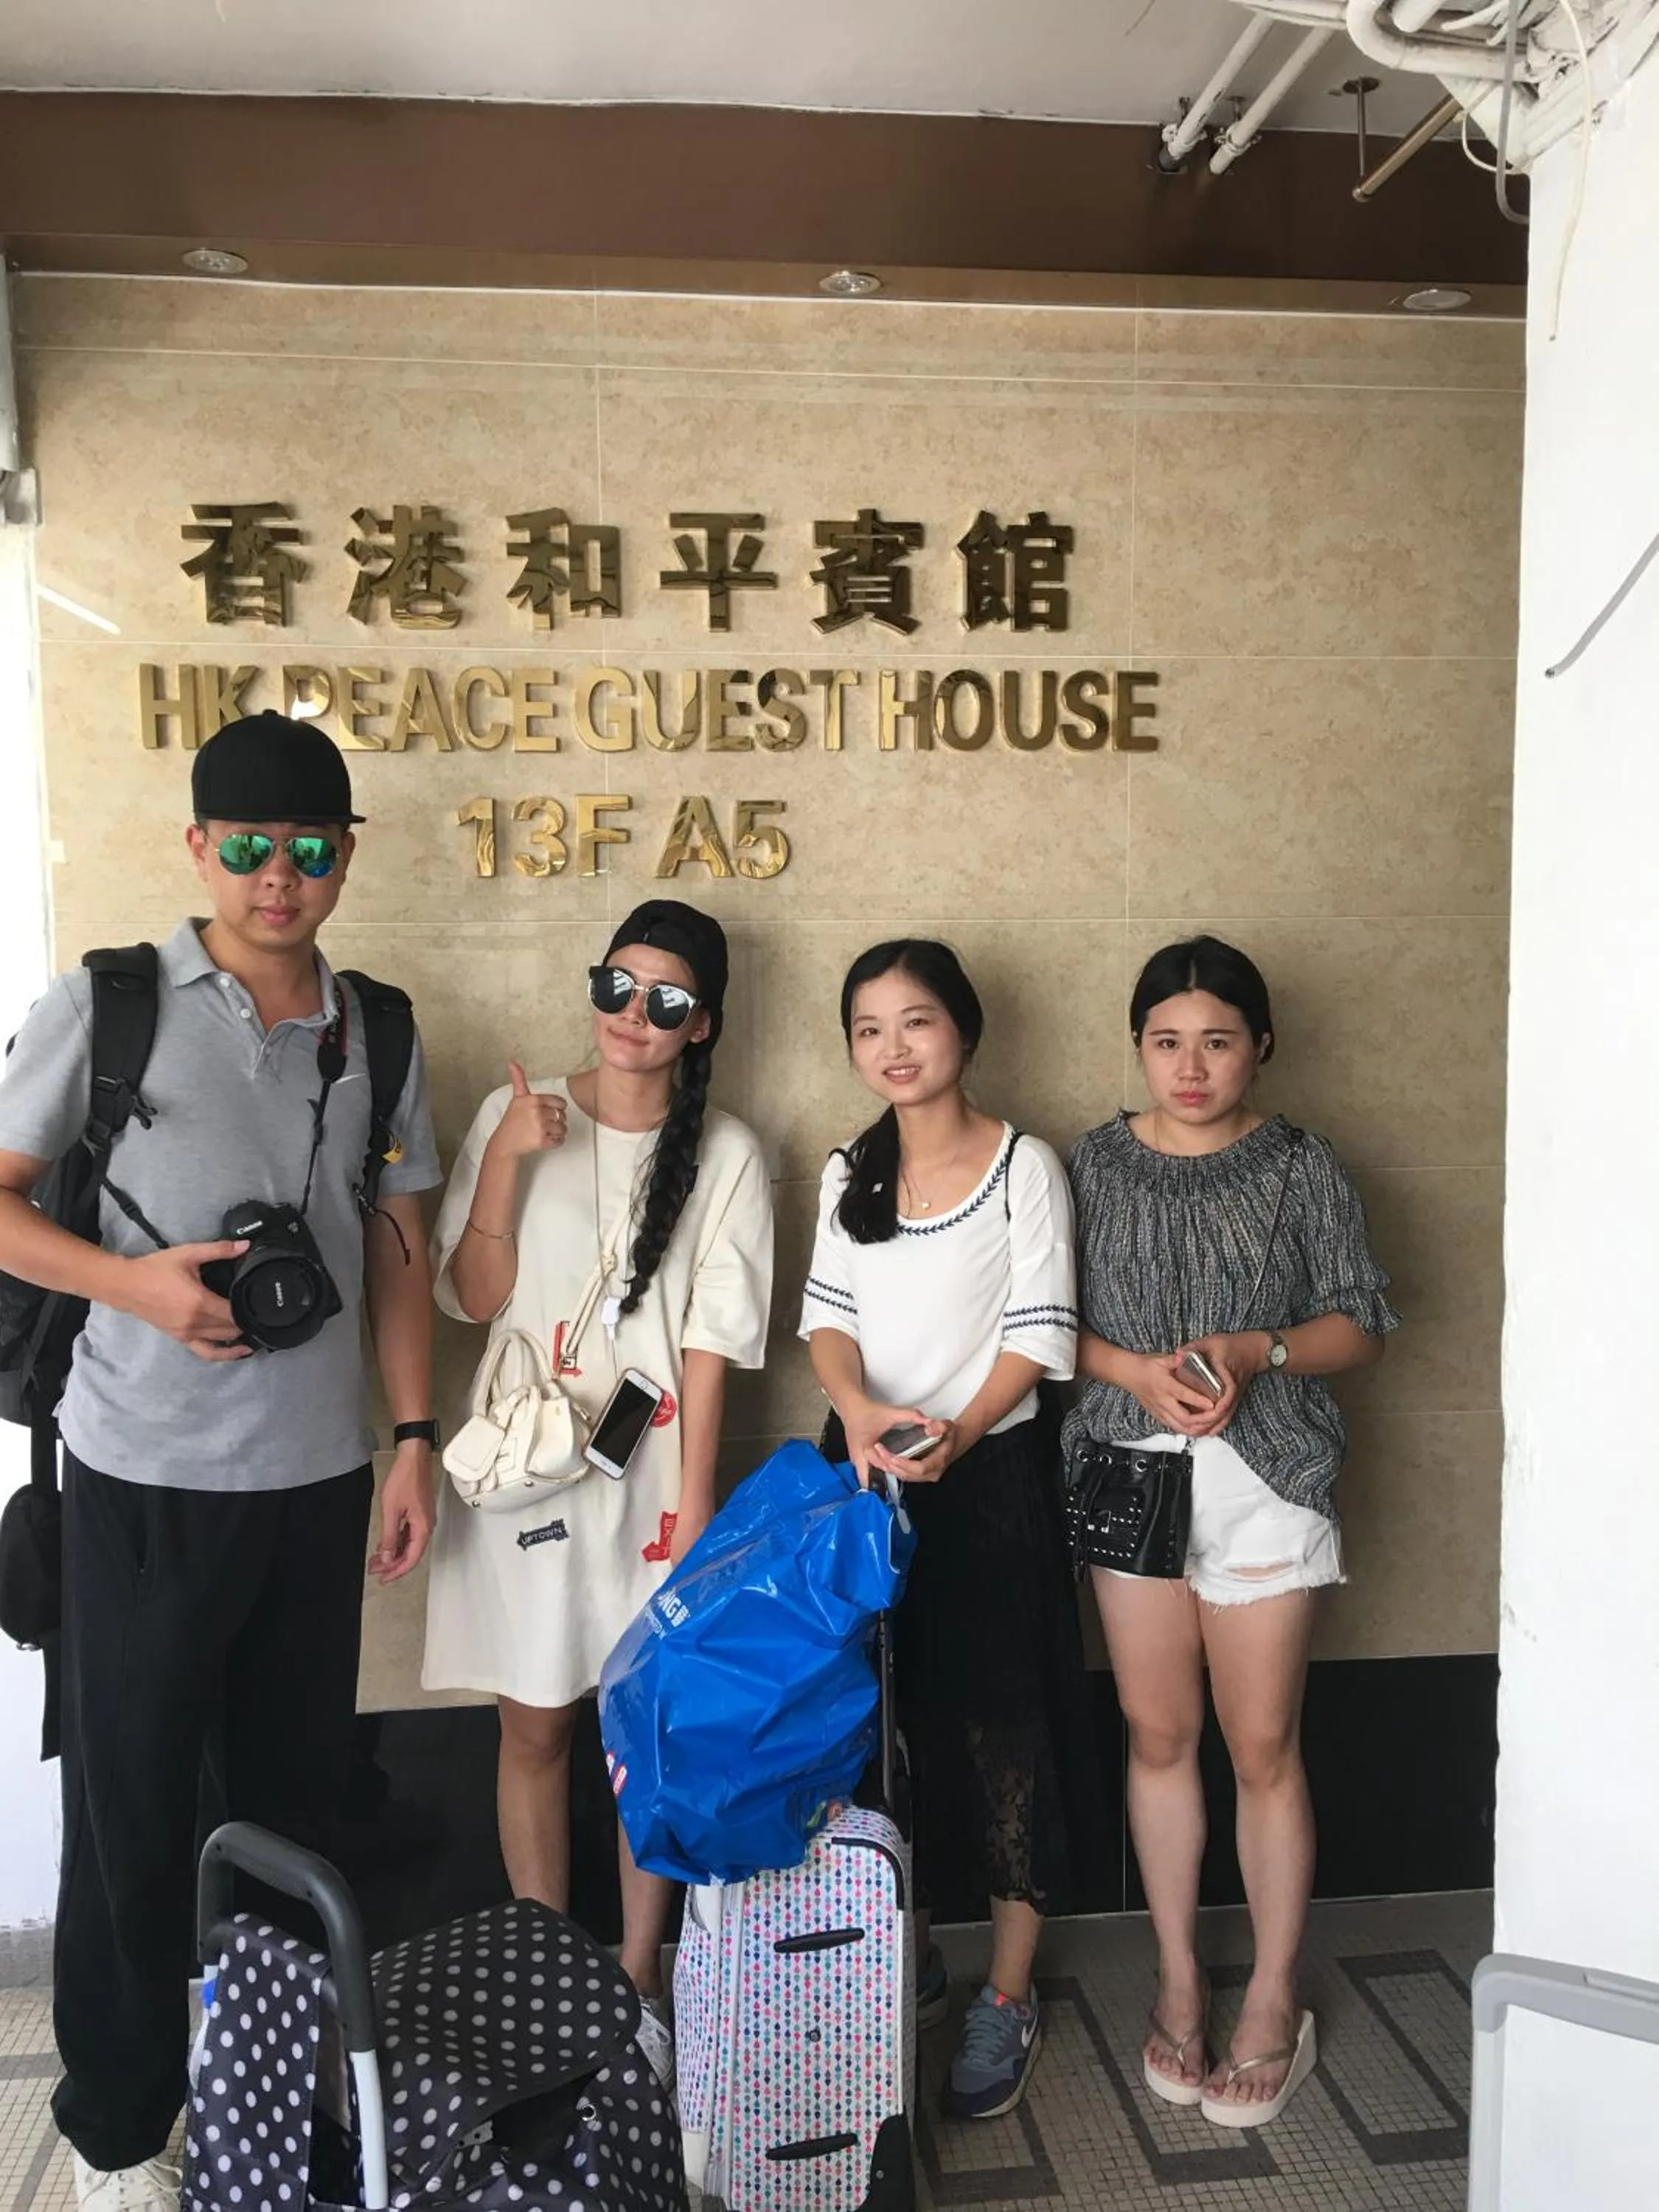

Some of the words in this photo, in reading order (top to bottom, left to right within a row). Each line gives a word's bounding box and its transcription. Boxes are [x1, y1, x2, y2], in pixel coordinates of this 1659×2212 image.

[180, 501, 1074, 636] 香港和平賓館
[139, 663, 260, 750] HK
[282, 664, 560, 752] PEACE
[573, 667, 860, 752] GUEST
[878, 668, 1160, 752] HOUSE
[456, 793, 632, 878] 13F
[655, 795, 790, 879] A5
[521, 1526, 563, 1545] UPTOWN
